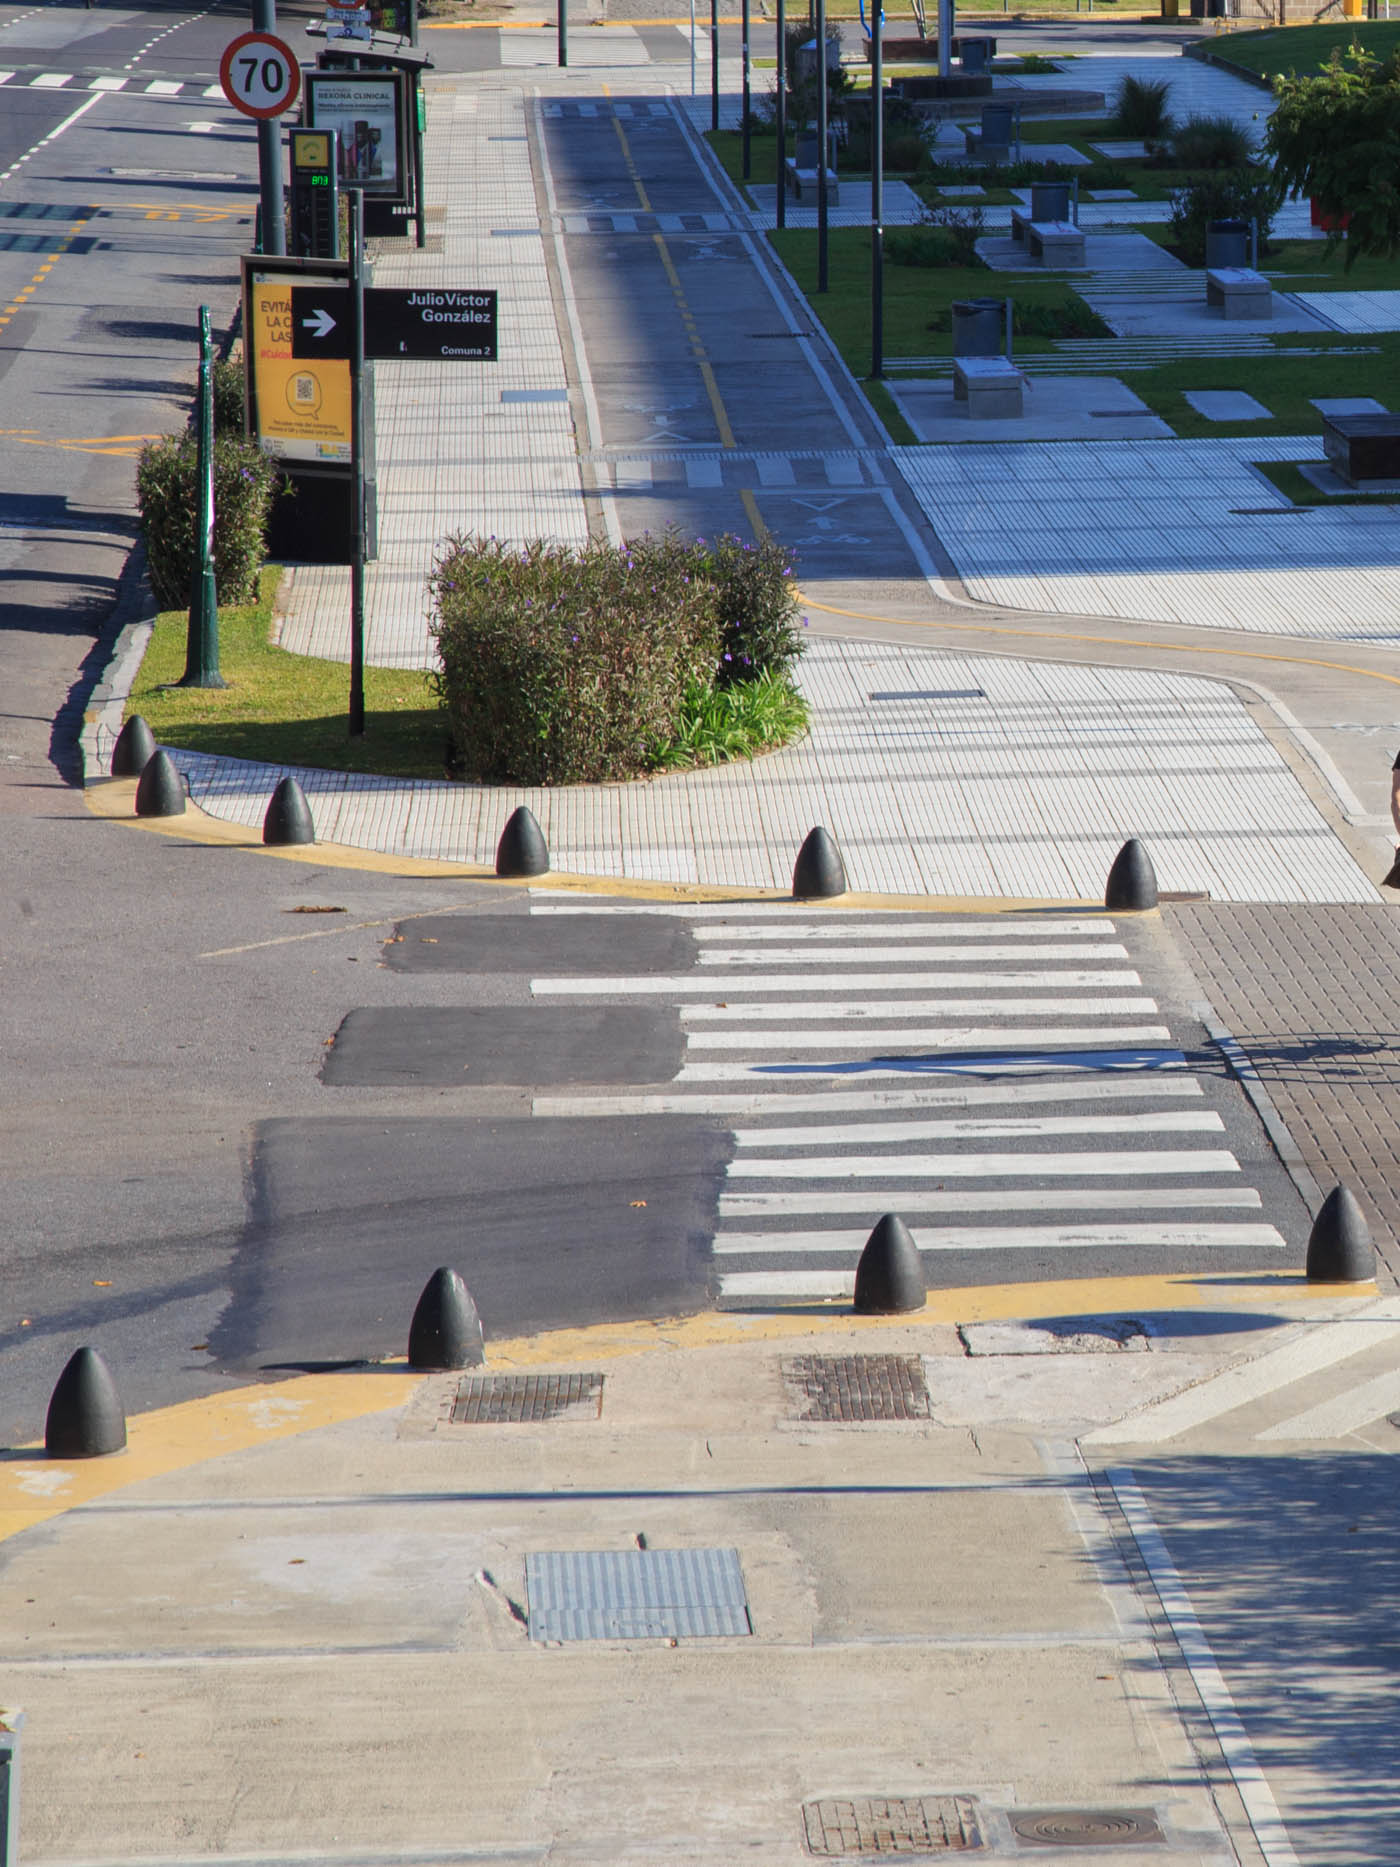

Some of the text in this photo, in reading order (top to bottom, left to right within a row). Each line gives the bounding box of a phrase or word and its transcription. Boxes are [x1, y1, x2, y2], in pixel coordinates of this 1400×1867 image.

[239, 58, 283, 93] 70
[407, 291, 490, 307] Julio Víctor
[266, 315, 283, 328] LA
[422, 308, 491, 324] González
[271, 330, 293, 343] LAS
[441, 345, 491, 356] Comuna 2
